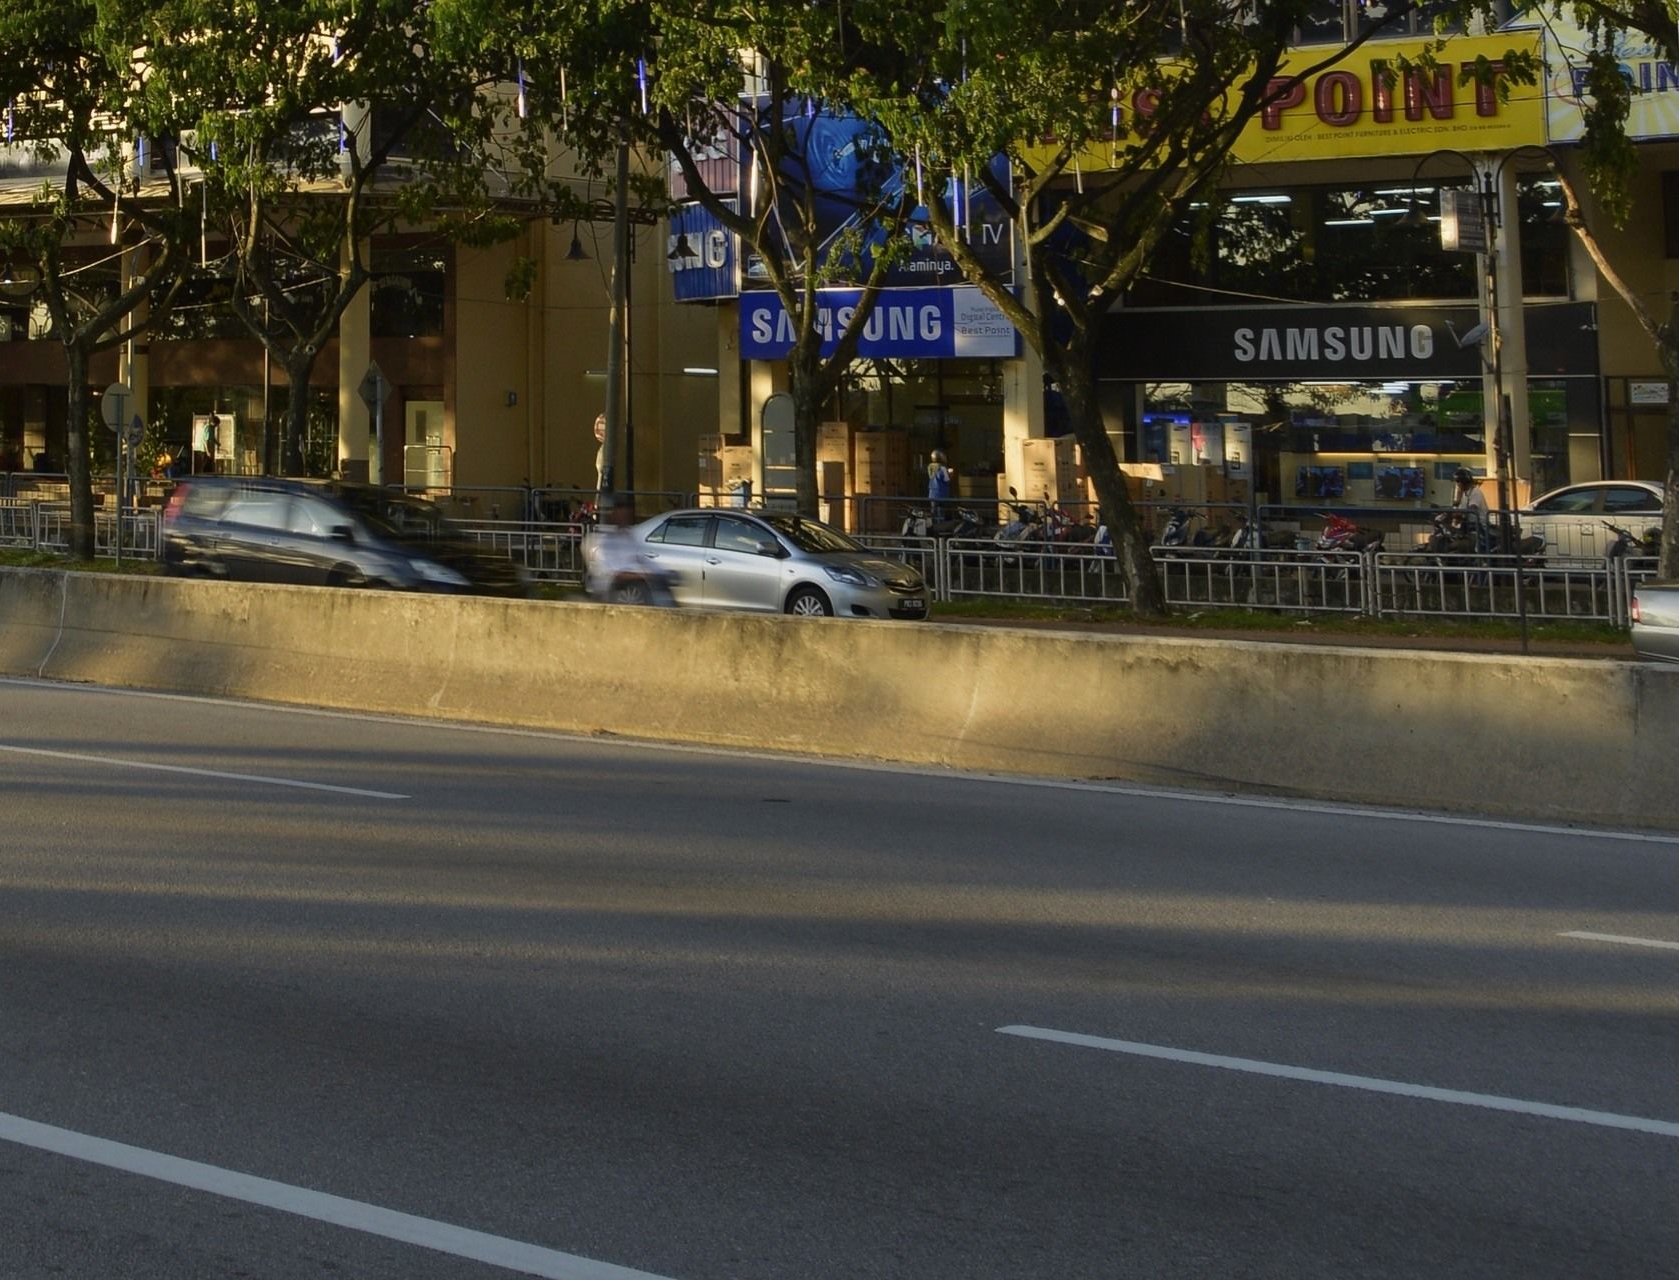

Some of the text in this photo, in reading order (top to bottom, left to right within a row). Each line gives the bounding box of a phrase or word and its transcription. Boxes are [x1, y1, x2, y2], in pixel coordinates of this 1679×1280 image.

[1261, 58, 1509, 131] POINT
[1334, 131, 1354, 139] POINT
[1355, 129, 1391, 138] FURNITURE
[1400, 126, 1432, 135] ELECTRIC
[898, 258, 954, 275] Aaminya.
[961, 326, 1011, 335] Best Point
[1234, 324, 1433, 361] SAMSUNG
